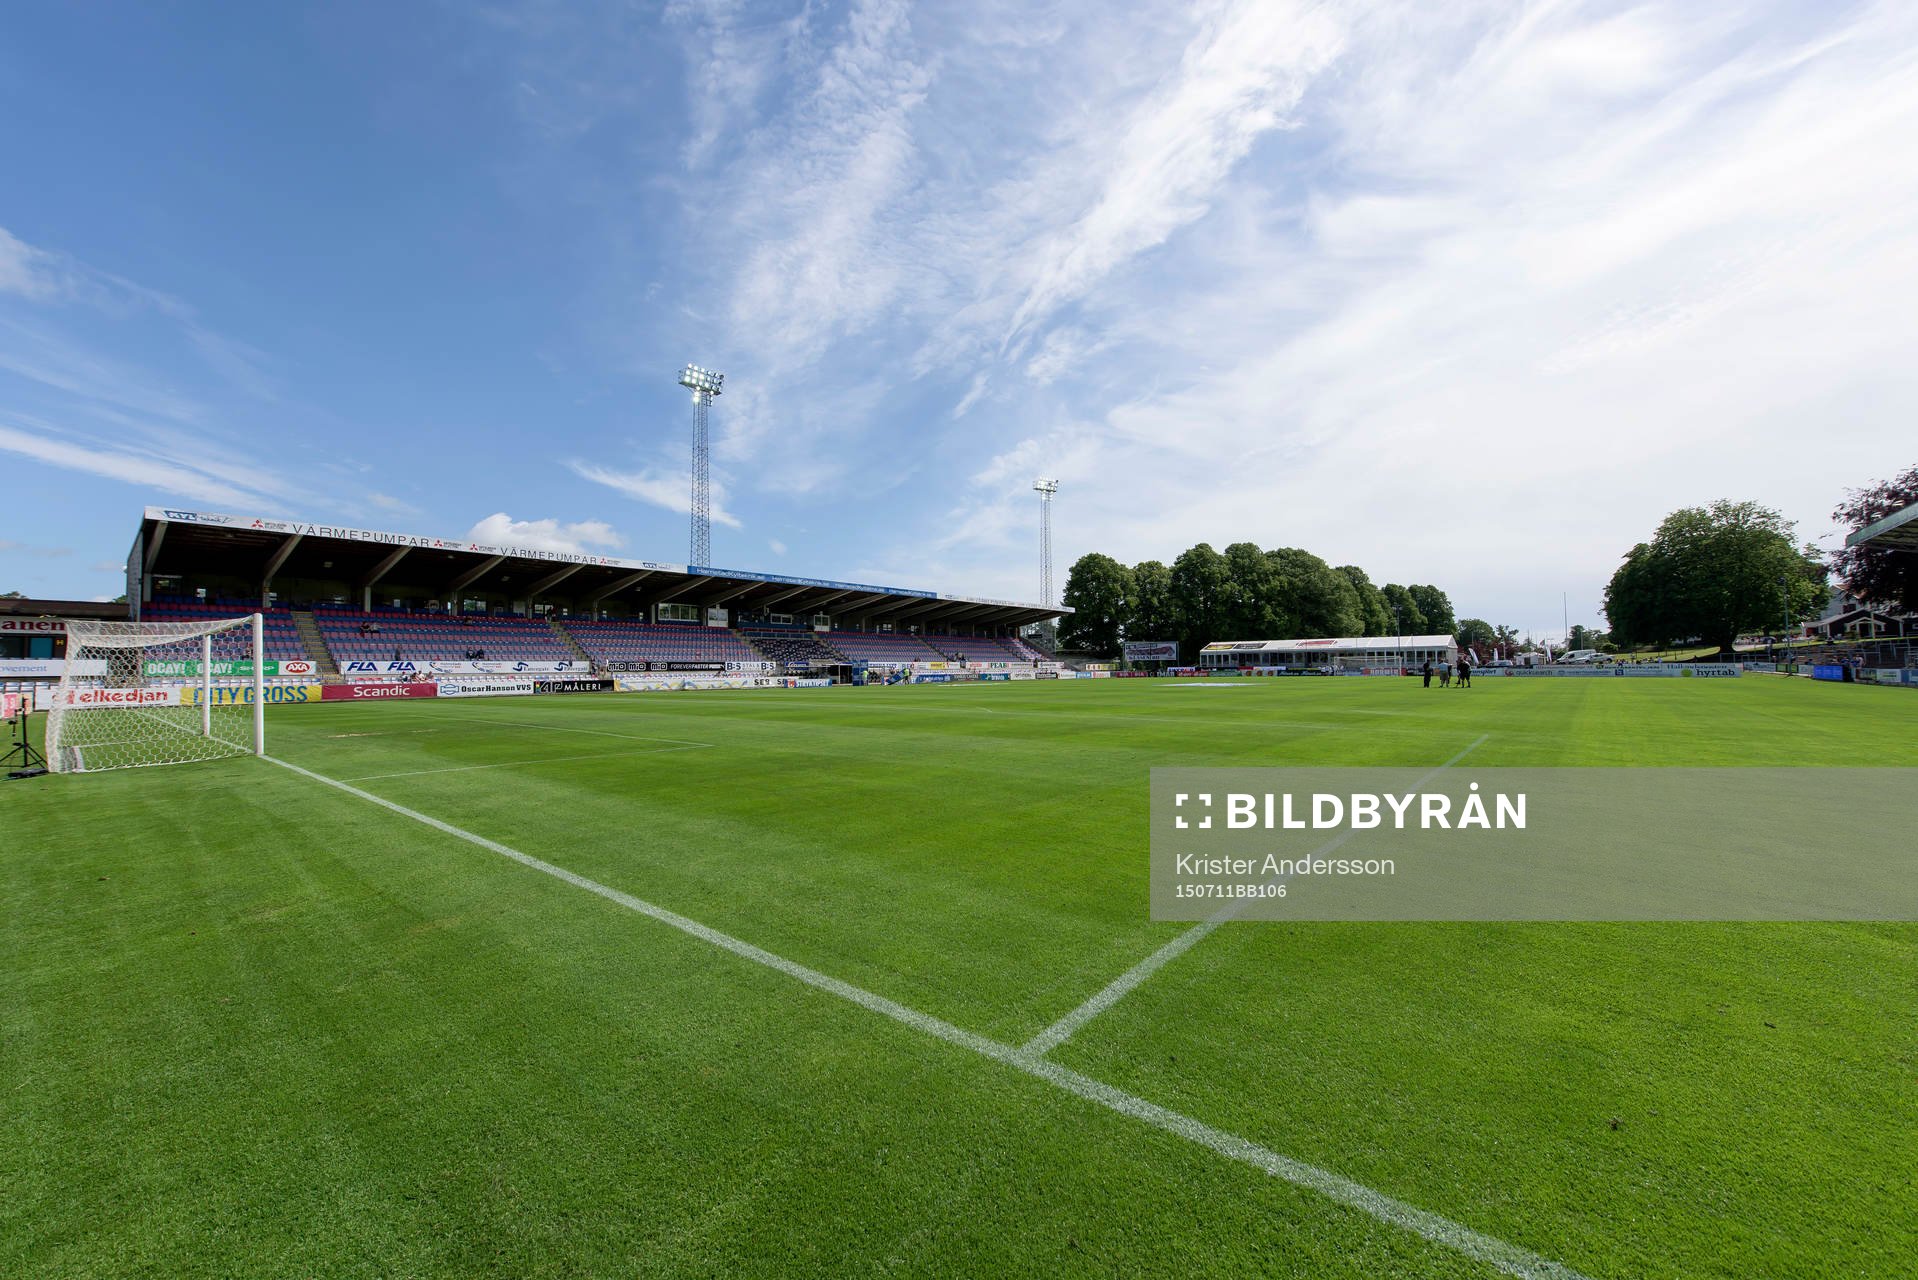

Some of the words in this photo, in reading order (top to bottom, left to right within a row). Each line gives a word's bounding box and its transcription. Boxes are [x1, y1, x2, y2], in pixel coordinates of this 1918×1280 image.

[293, 523, 430, 547] VÄRMEPUMPAR
[500, 546, 597, 565] VÄRMEPUMPAR
[1, 620, 66, 631] anen
[285, 662, 310, 671] AXA
[347, 661, 378, 671] FLA
[387, 661, 416, 671] FLA
[1696, 668, 1735, 677] hyrtab
[353, 685, 411, 697] Scandic
[564, 682, 601, 692] MÅLERI
[194, 687, 240, 704] CITY
[244, 686, 308, 703] GROSS
